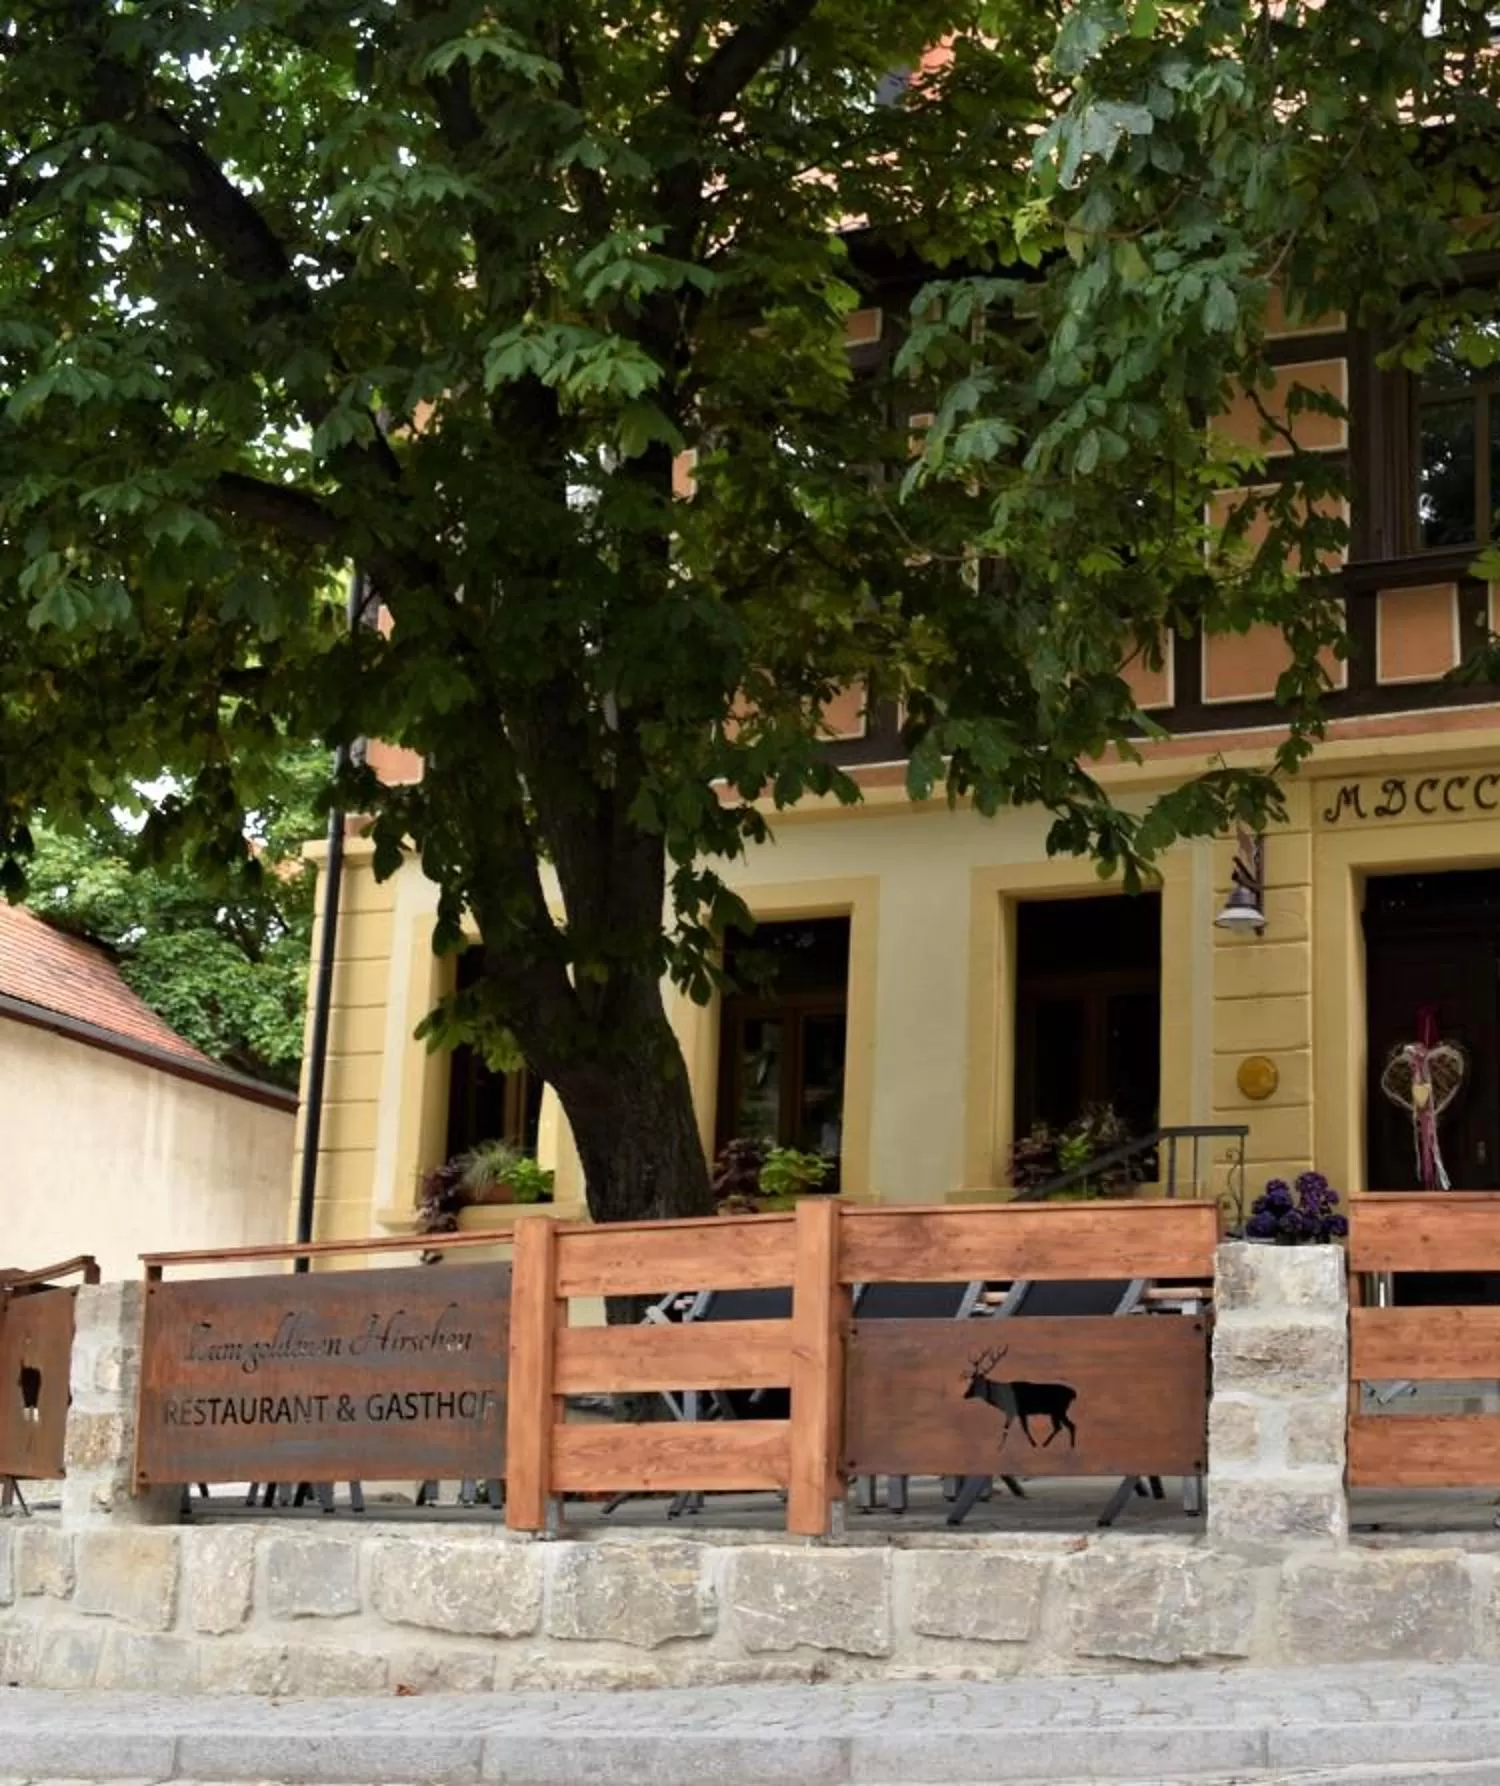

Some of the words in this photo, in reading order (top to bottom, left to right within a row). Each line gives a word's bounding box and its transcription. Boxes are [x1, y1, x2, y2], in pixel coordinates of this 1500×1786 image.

[164, 1396, 329, 1426] RESTAURANT
[336, 1393, 356, 1422] &
[366, 1389, 496, 1422] GASTHOF
